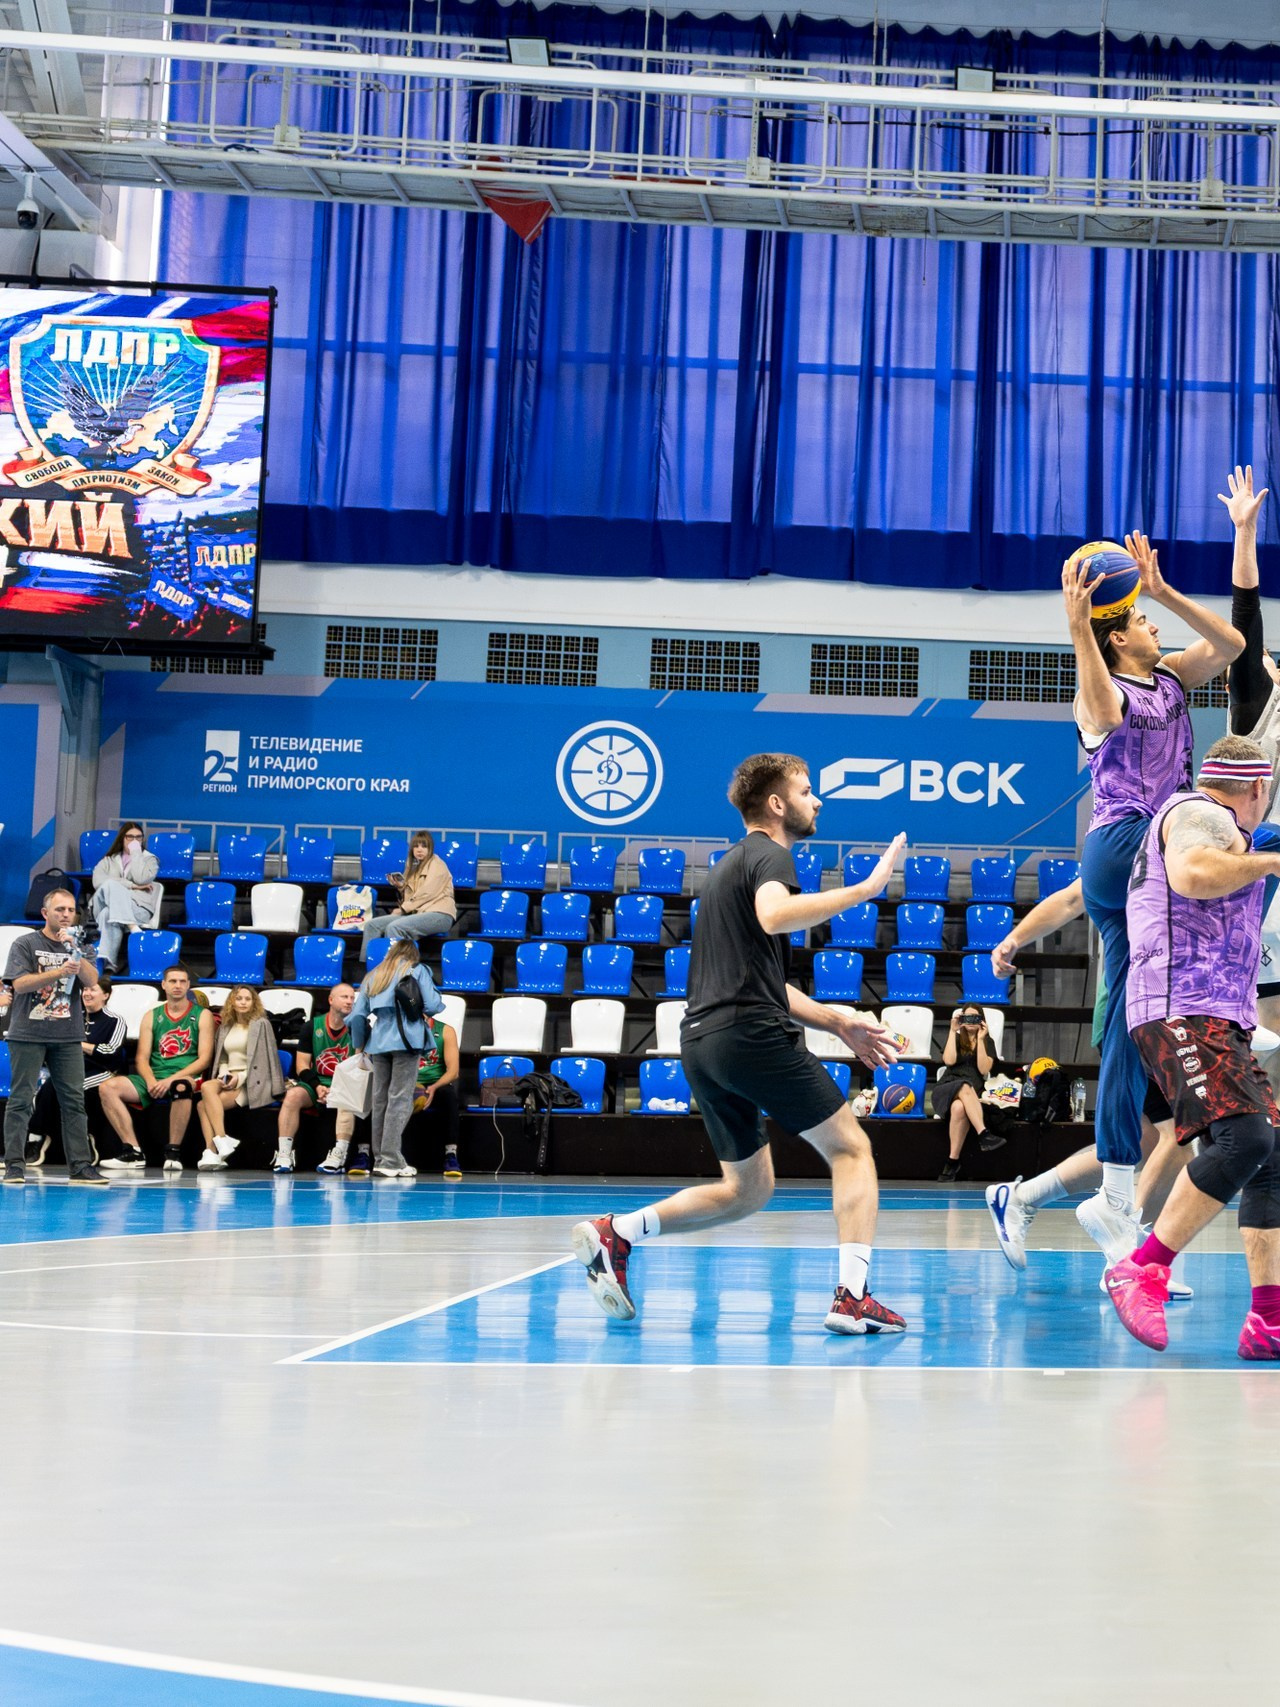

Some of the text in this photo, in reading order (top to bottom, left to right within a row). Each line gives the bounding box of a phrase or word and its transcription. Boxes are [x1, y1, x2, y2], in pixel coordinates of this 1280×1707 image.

[51, 329, 181, 368] ЛДПР
[24, 459, 73, 483] СВОБОДА
[147, 466, 180, 486] ЗАКОН
[71, 474, 141, 490] ПАТРИОТИЗМ
[194, 543, 257, 569] ЛДПР
[250, 736, 363, 754] ТЕЛЕВИДЕНИЕ
[248, 756, 318, 772] И РАДИО
[202, 783, 237, 793] РЕГИОН
[247, 775, 410, 793] ПРИМОРСКОГО КРАЯ
[910, 760, 1026, 808] ВСК
